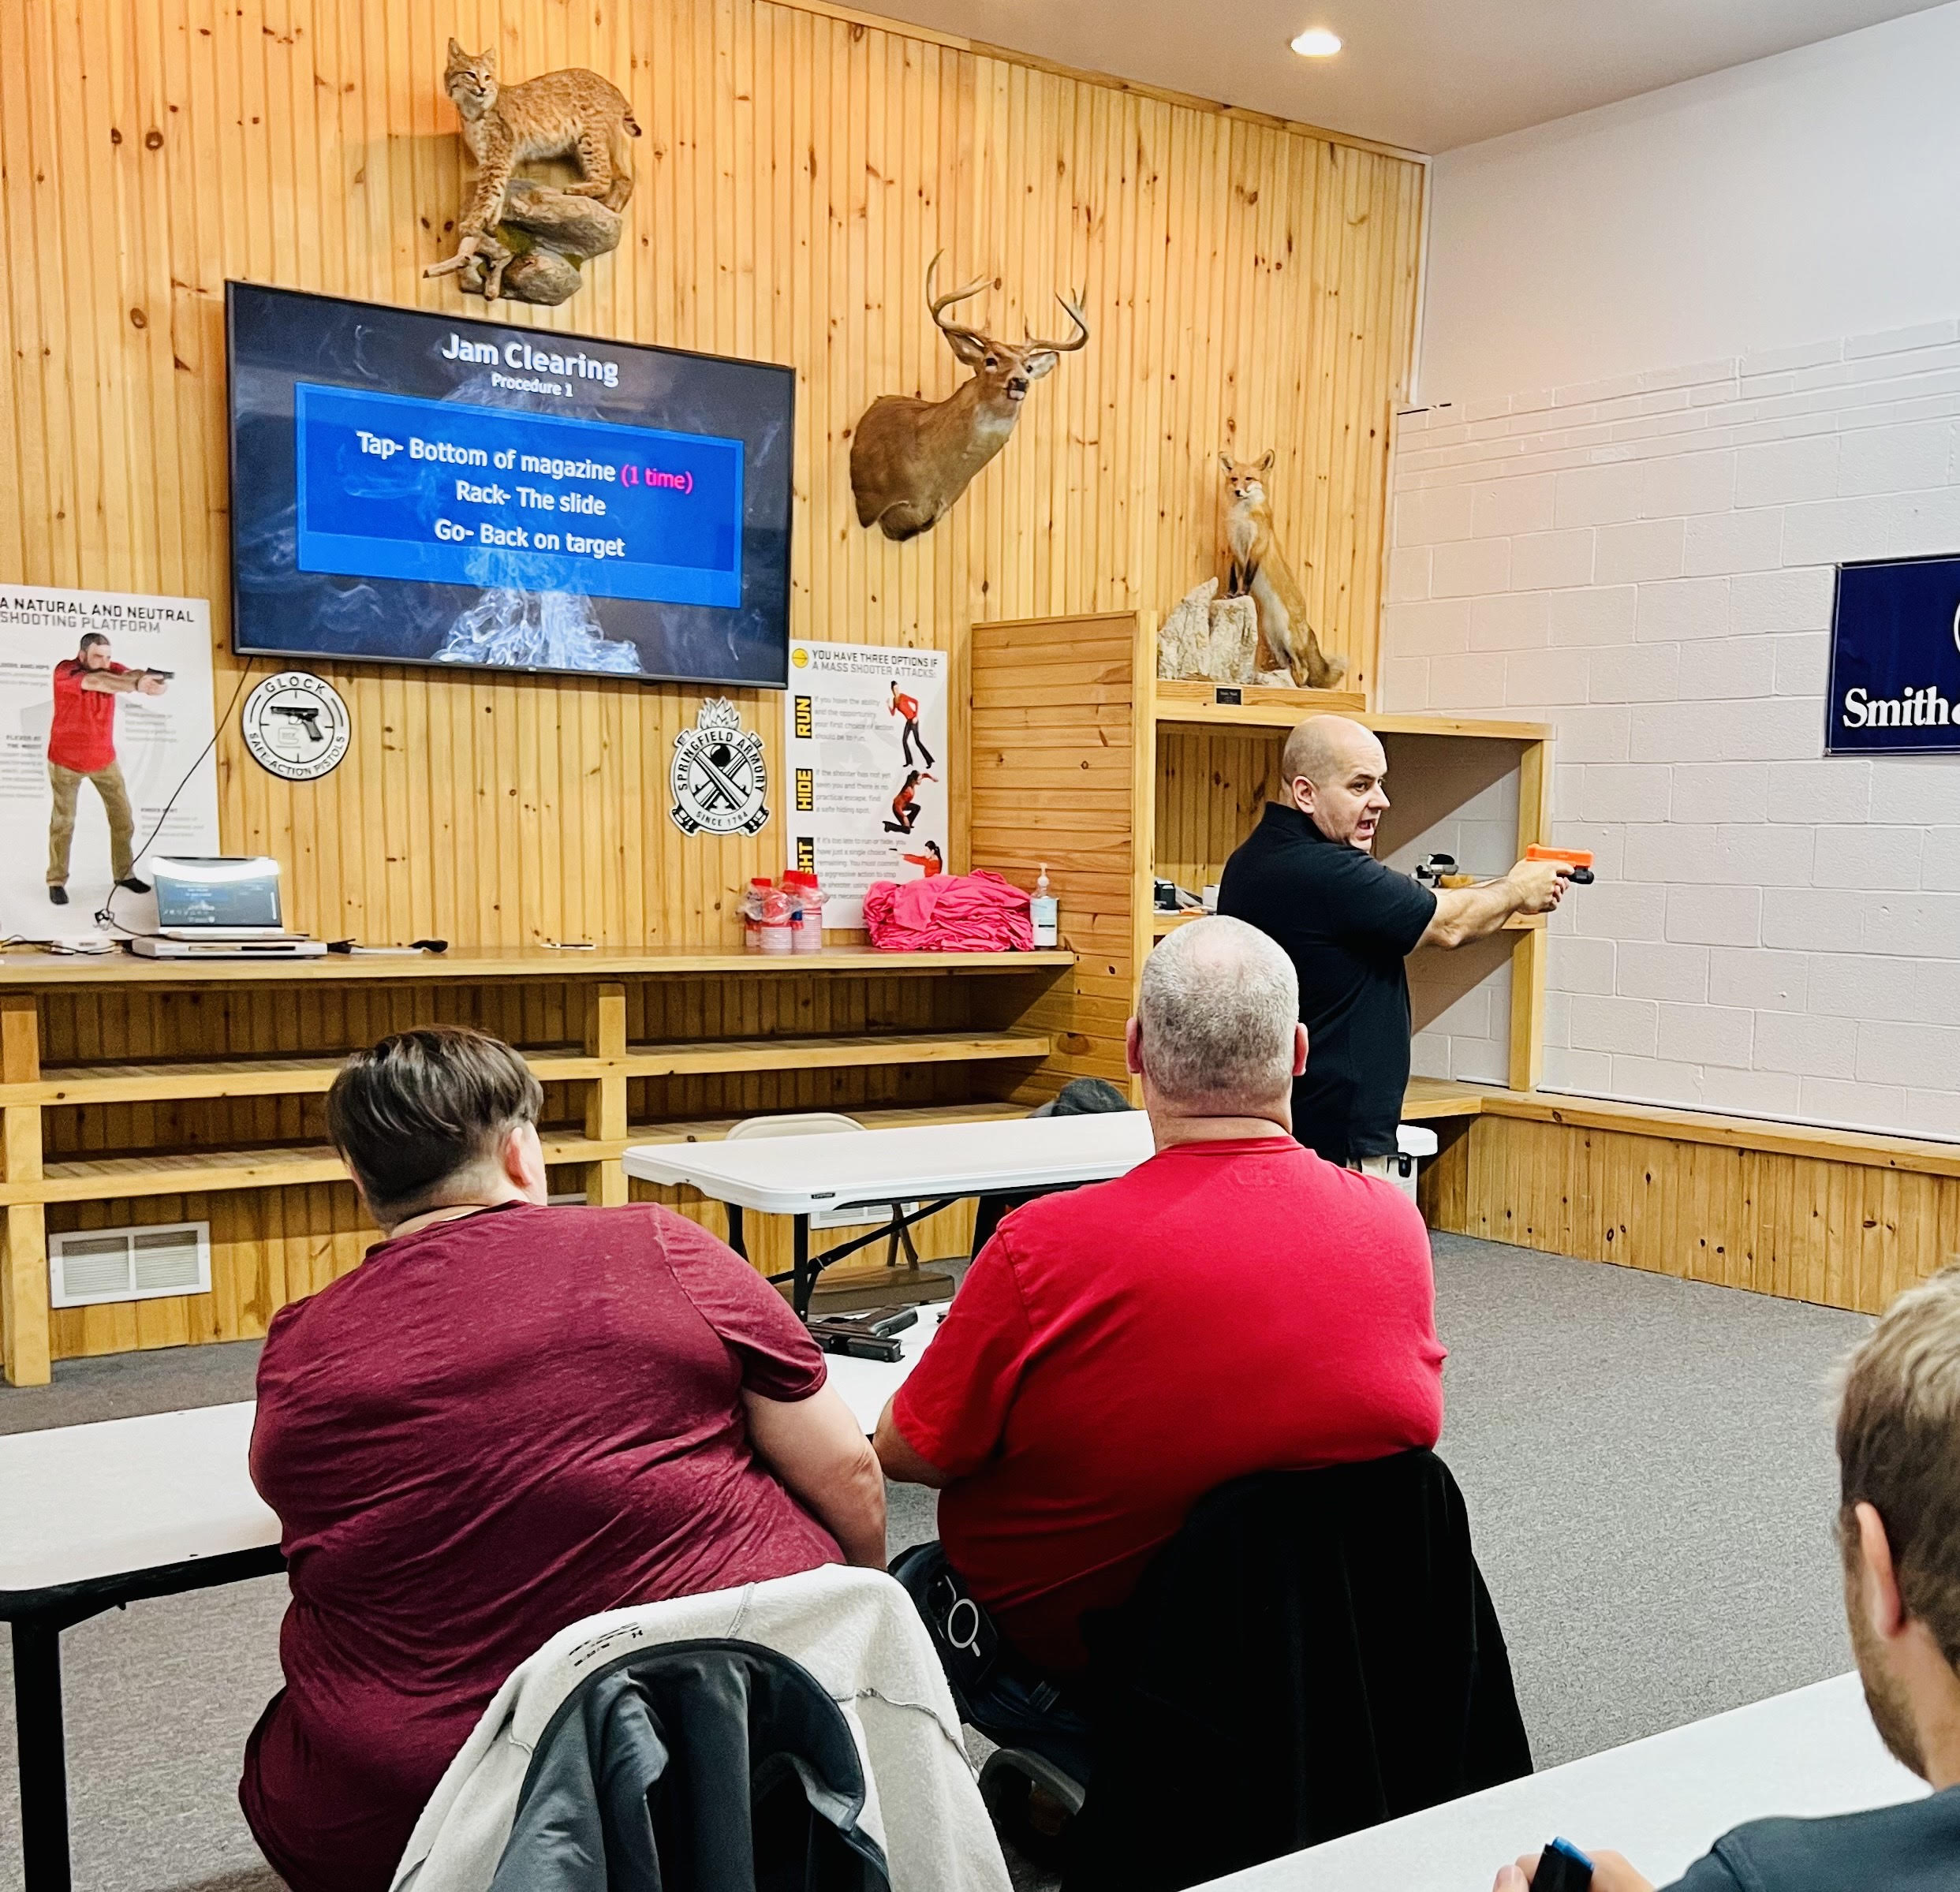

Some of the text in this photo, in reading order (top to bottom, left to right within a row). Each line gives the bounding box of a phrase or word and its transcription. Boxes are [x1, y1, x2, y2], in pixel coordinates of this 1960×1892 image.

[442, 333, 618, 387] Jam Clearing
[491, 372, 573, 397] Procedure 1
[357, 431, 693, 494] Tap- Bottom of magazine (1 time)
[456, 480, 606, 516] Rack- The slide
[435, 519, 625, 559] Go- Back on target
[0, 597, 195, 622] A NATURAL AND NEUTRAL
[0, 611, 161, 633] SHOOTING PLATFORM
[812, 650, 938, 667] YOU HAVE THREE OPTIONS IF
[812, 662, 936, 678] A MASS SHOOTER ATTACKS:
[265, 676, 326, 694] GLOCK
[797, 698, 811, 736] RUN
[314, 736, 345, 773] PISTOLS
[678, 731, 765, 792] SPRINGFIELD ARMORY
[797, 770, 812, 810] HIDE
[696, 811, 749, 827] SINCE 1794
